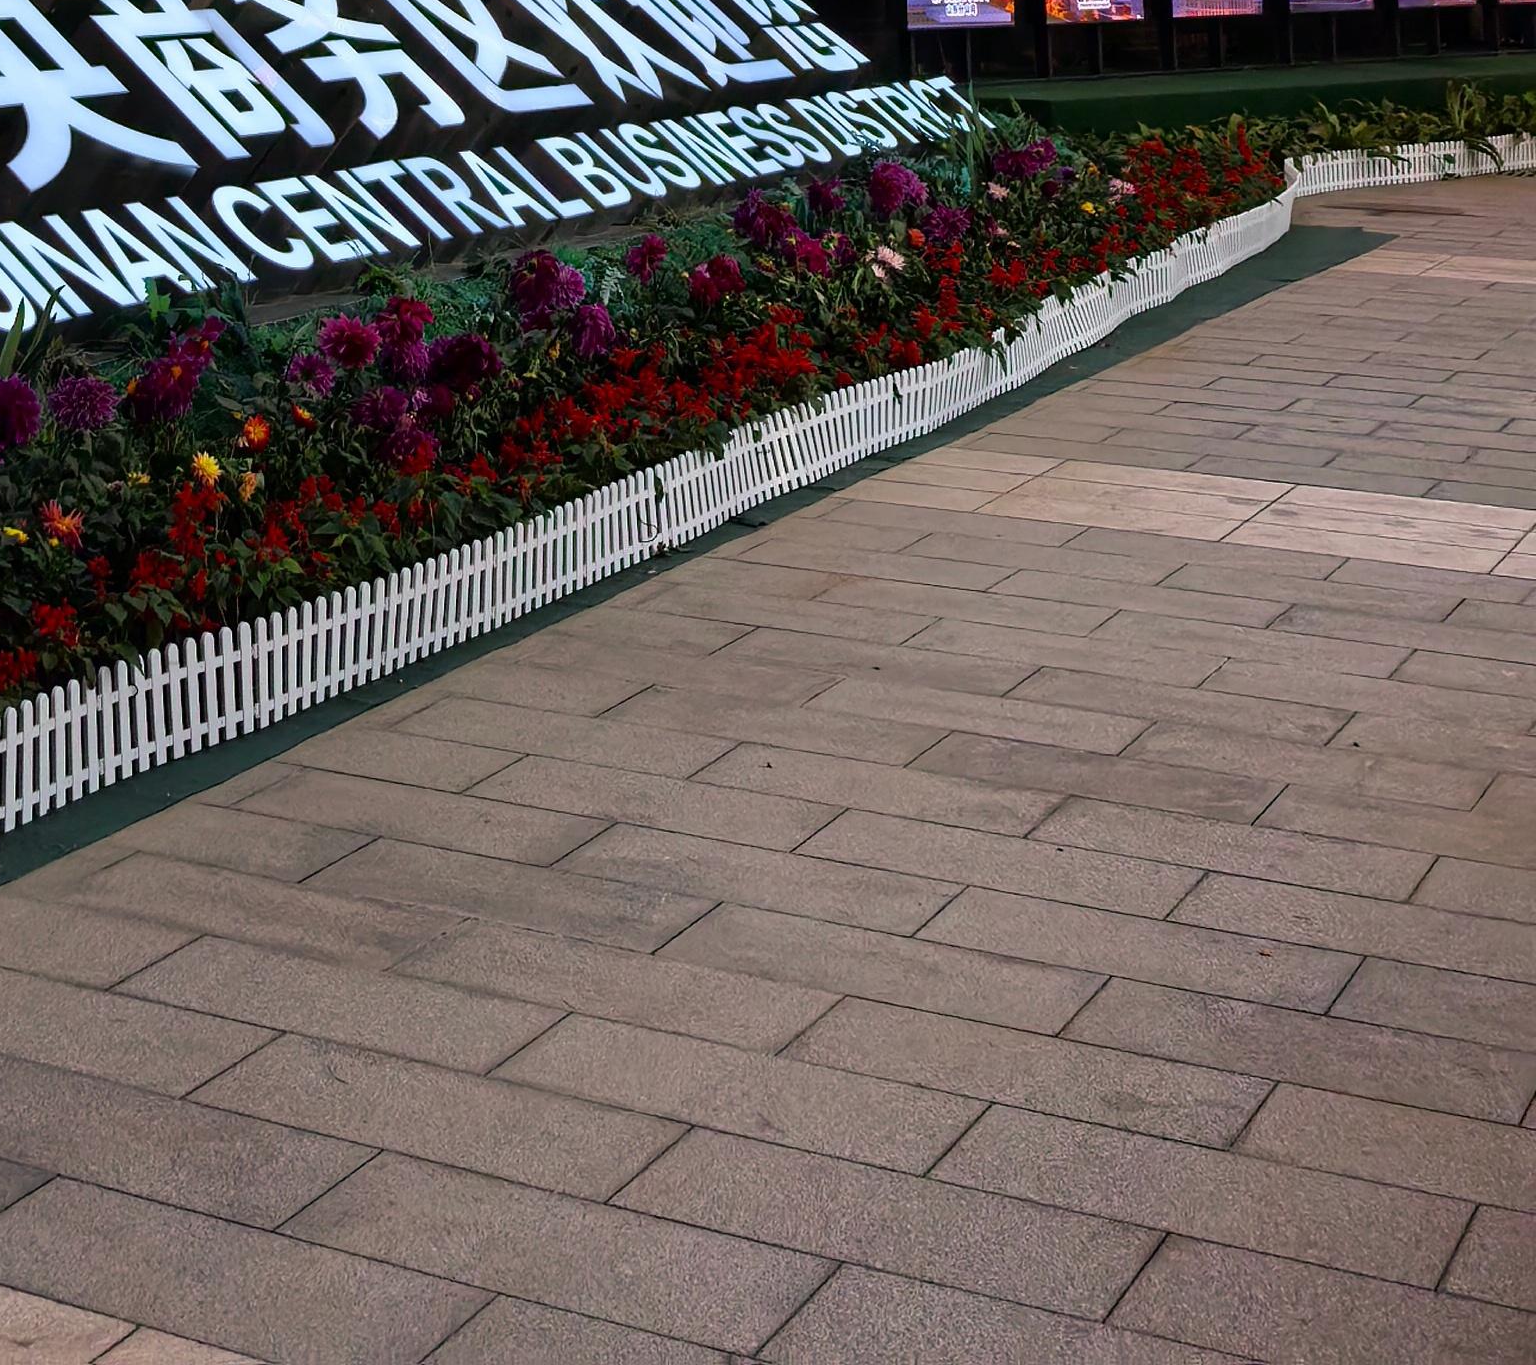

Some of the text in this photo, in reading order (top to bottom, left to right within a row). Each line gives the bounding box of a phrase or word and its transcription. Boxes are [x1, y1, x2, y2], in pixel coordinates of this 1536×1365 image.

[212, 147, 595, 269] CENTRAL
[534, 103, 831, 209] BUSINESS
[785, 76, 995, 157] DISTRICT
